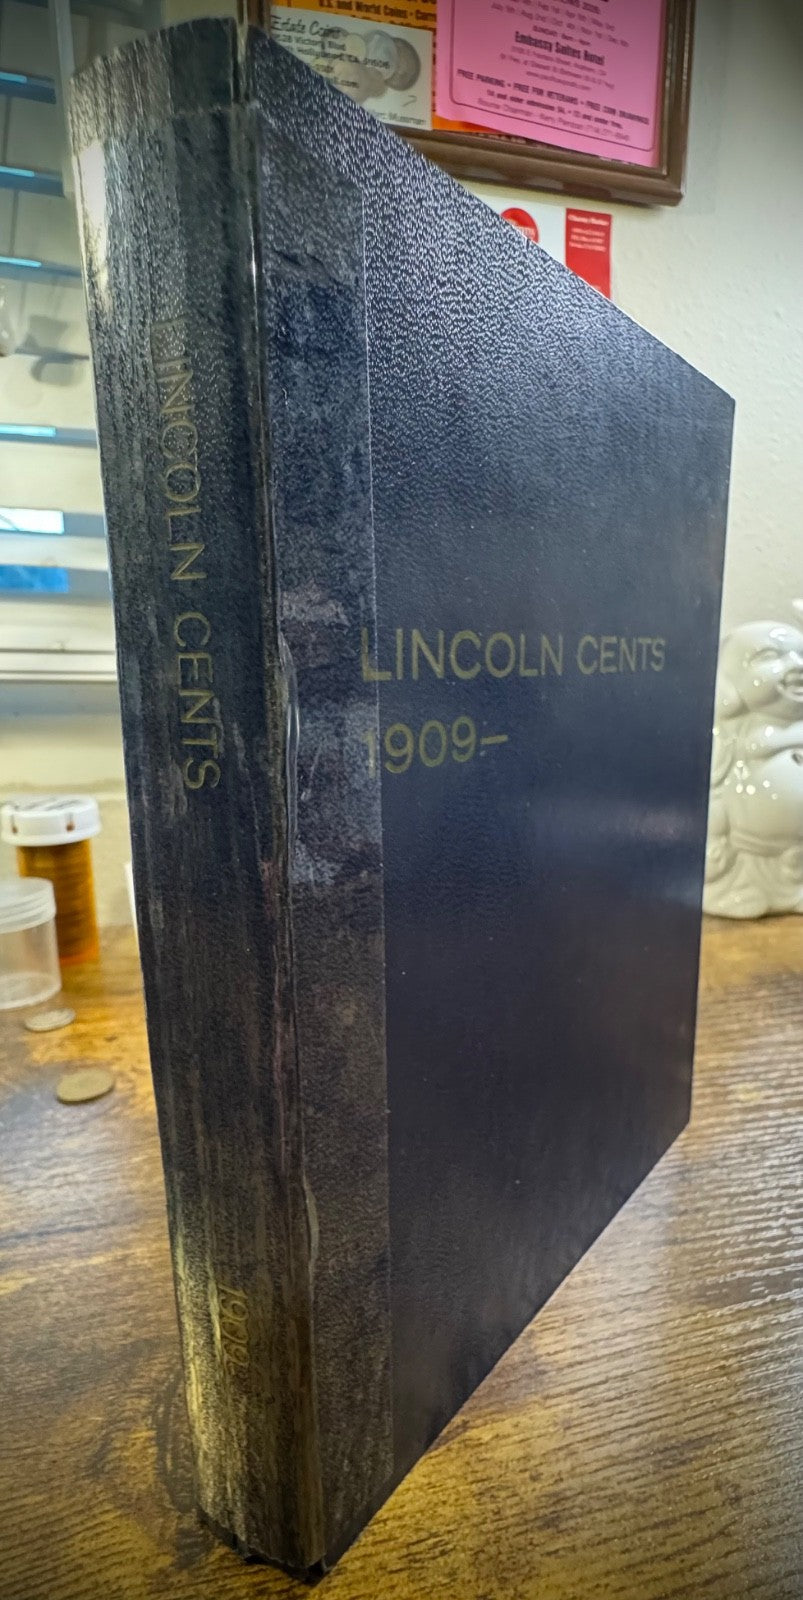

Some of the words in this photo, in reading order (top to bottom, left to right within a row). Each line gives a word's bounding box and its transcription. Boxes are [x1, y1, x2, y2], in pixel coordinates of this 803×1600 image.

[356, 2, 381, 15] World
[384, 5, 408, 19] Coins
[515, 31, 552, 52] Embassy
[555, 41, 581, 60] Suites
[583, 49, 605, 67] Hotel
[457, 68, 474, 80] FREE
[477, 73, 505, 88] PARKING
[513, 82, 529, 93] FREE
[532, 86, 544, 96] FOR
[547, 90, 578, 105] VETERANS
[586, 100, 600, 112] FREE
[150, 316, 207, 581] LINCOLN
[360, 626, 564, 683] LINCOLN
[577, 633, 667, 676] CENTS
[172, 611, 222, 790] CENTS
